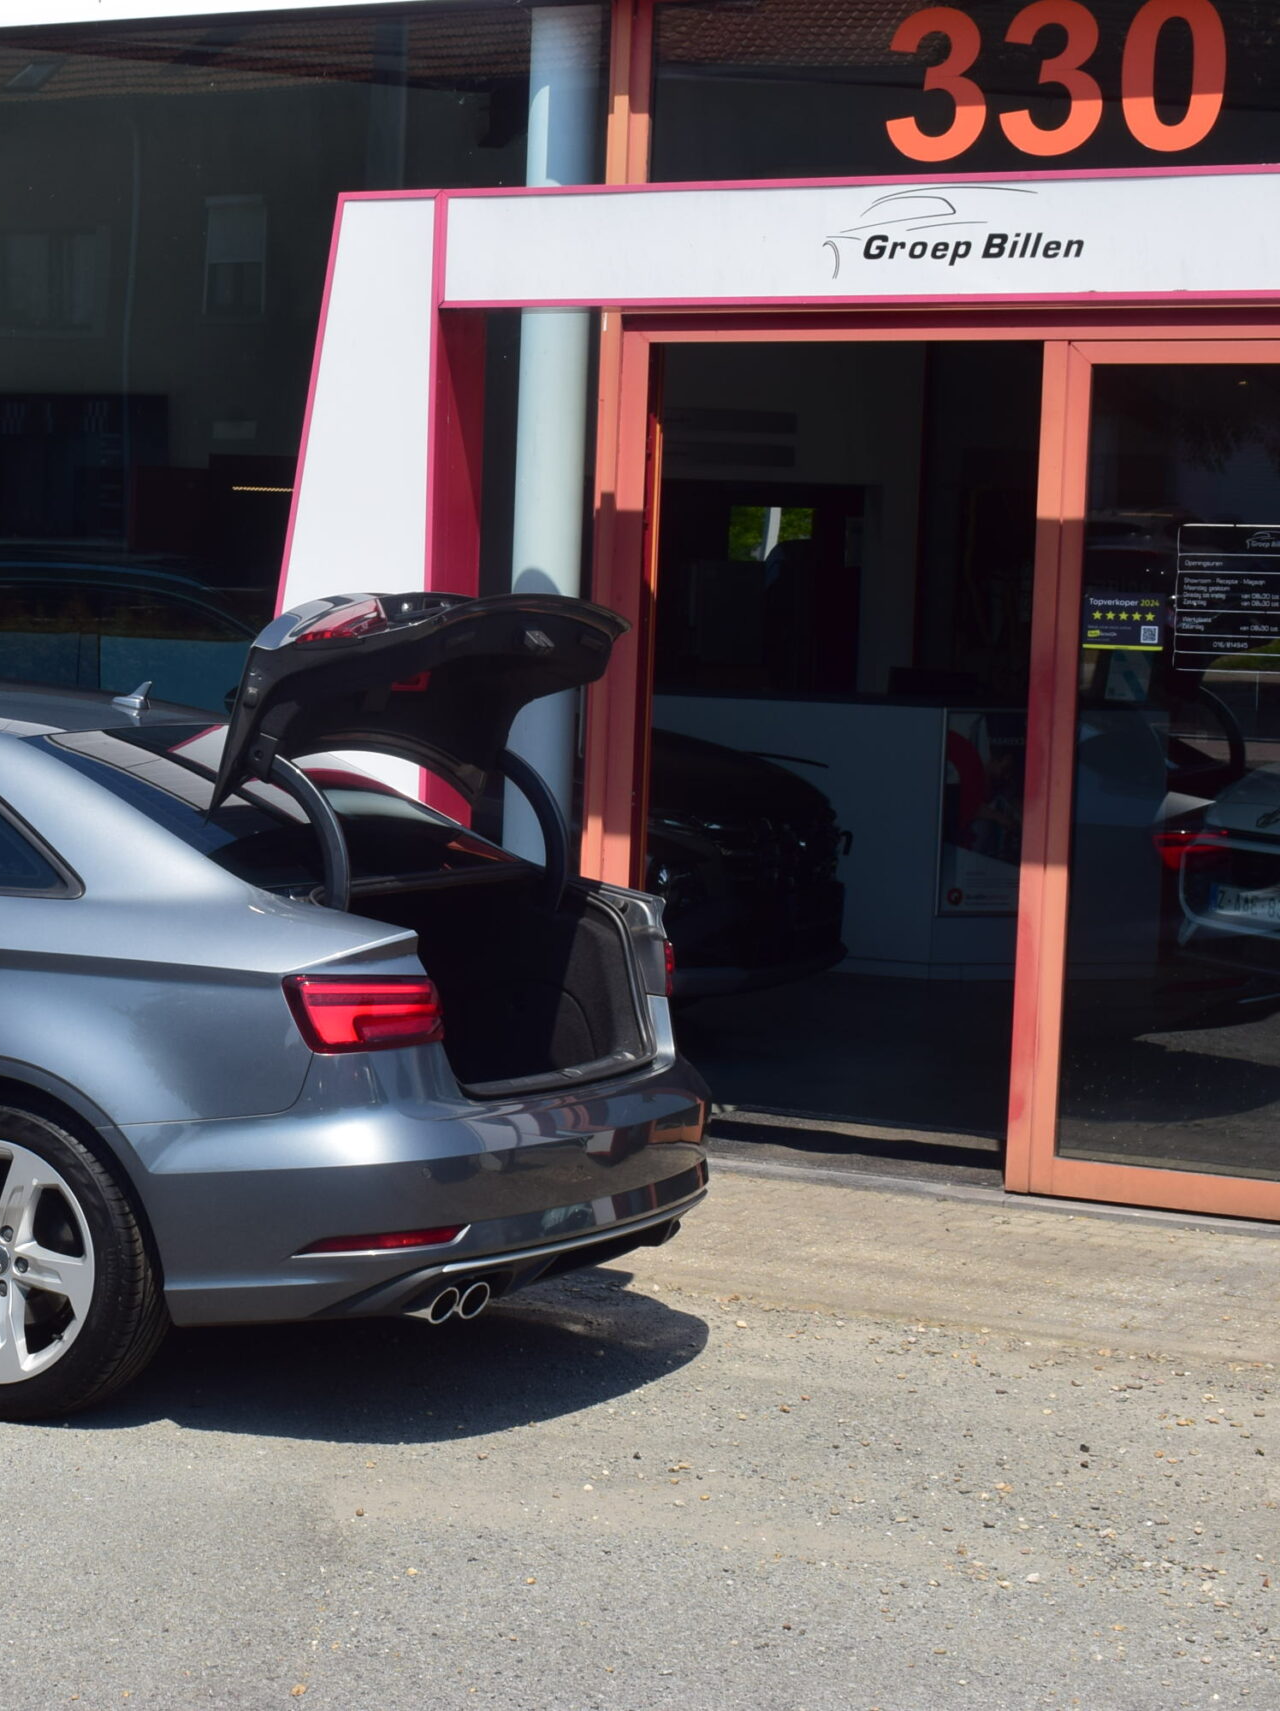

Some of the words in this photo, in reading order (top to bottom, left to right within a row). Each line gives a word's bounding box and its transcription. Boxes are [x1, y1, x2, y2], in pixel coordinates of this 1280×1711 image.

[885, 0, 1227, 162] 330
[862, 233, 972, 266] Groep
[981, 232, 1085, 259] Billen
[1089, 598, 1139, 608] Topverkoper
[1140, 599, 1160, 607] 2024
